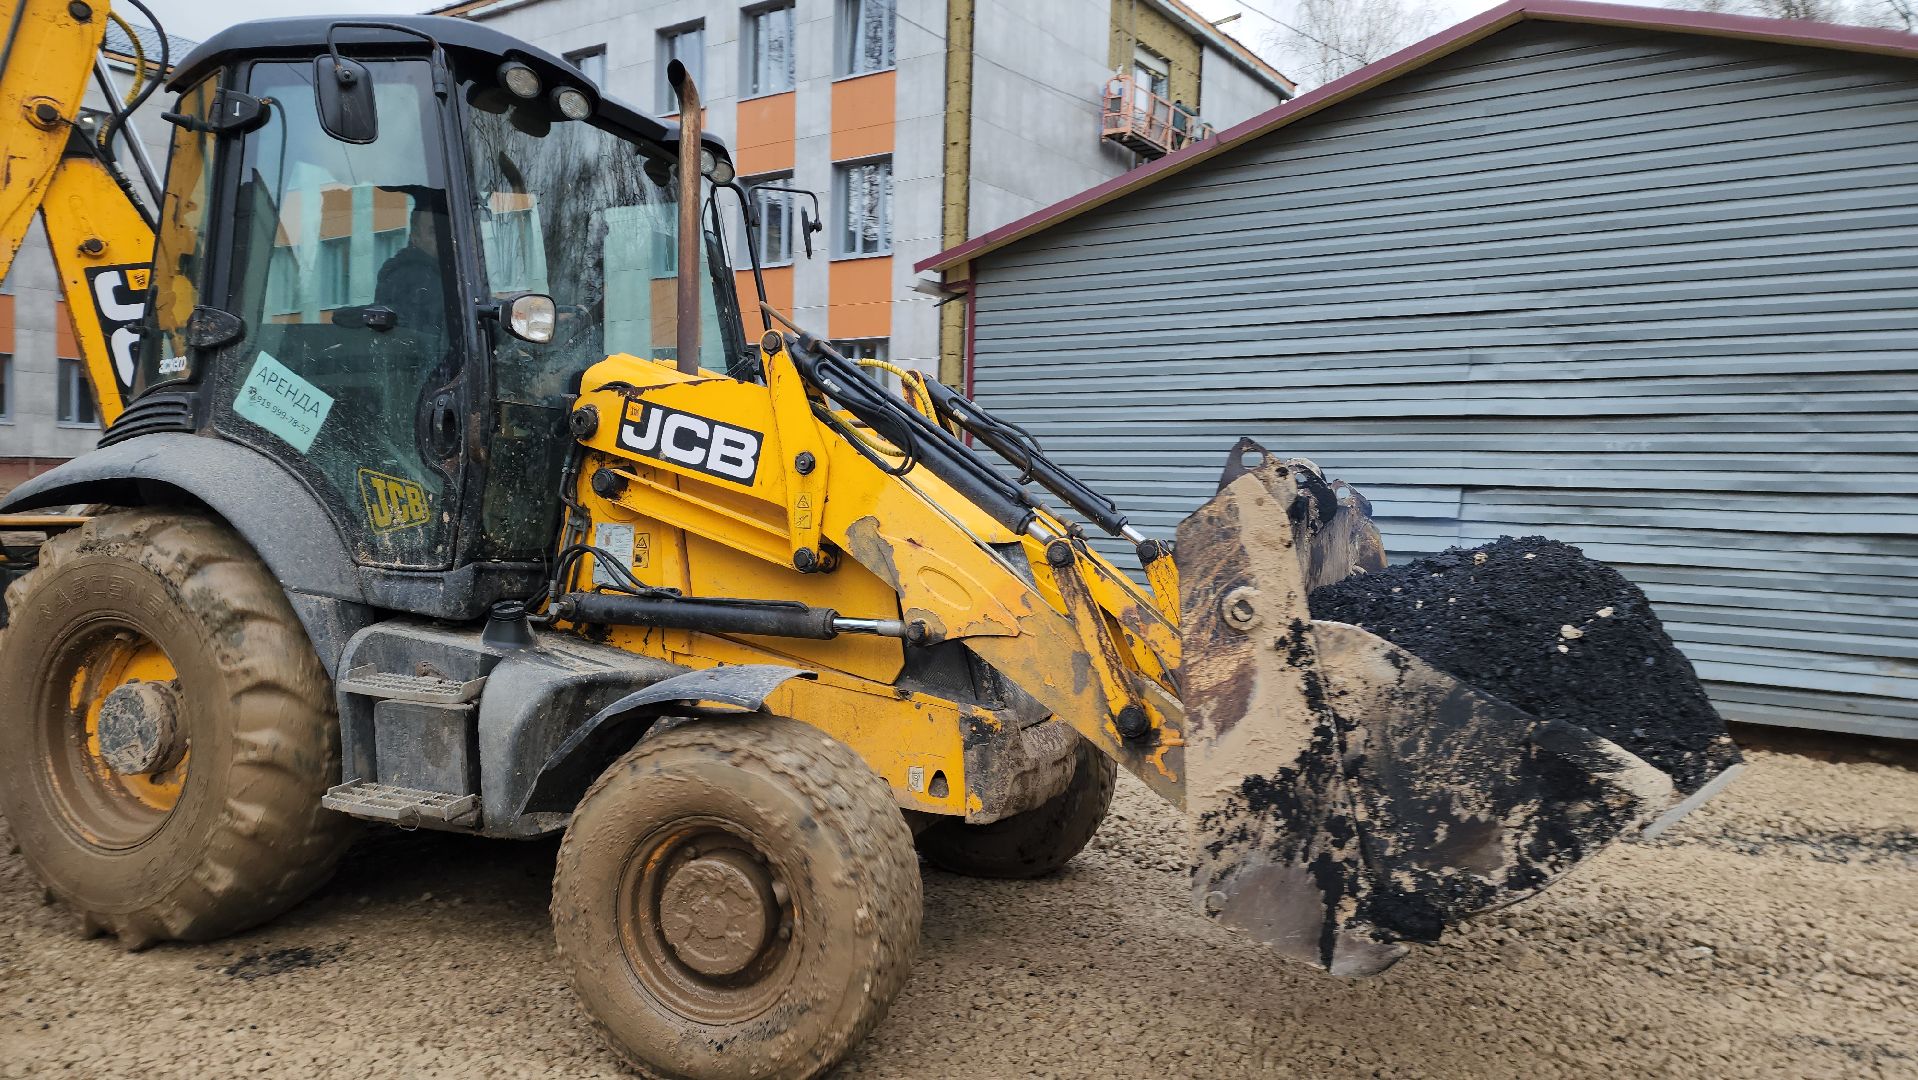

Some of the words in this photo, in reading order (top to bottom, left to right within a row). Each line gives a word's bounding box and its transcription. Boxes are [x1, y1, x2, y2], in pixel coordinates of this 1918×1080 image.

[255, 366, 321, 419] АРЕНДА
[621, 407, 758, 479] JCB
[370, 477, 424, 528] JCB
